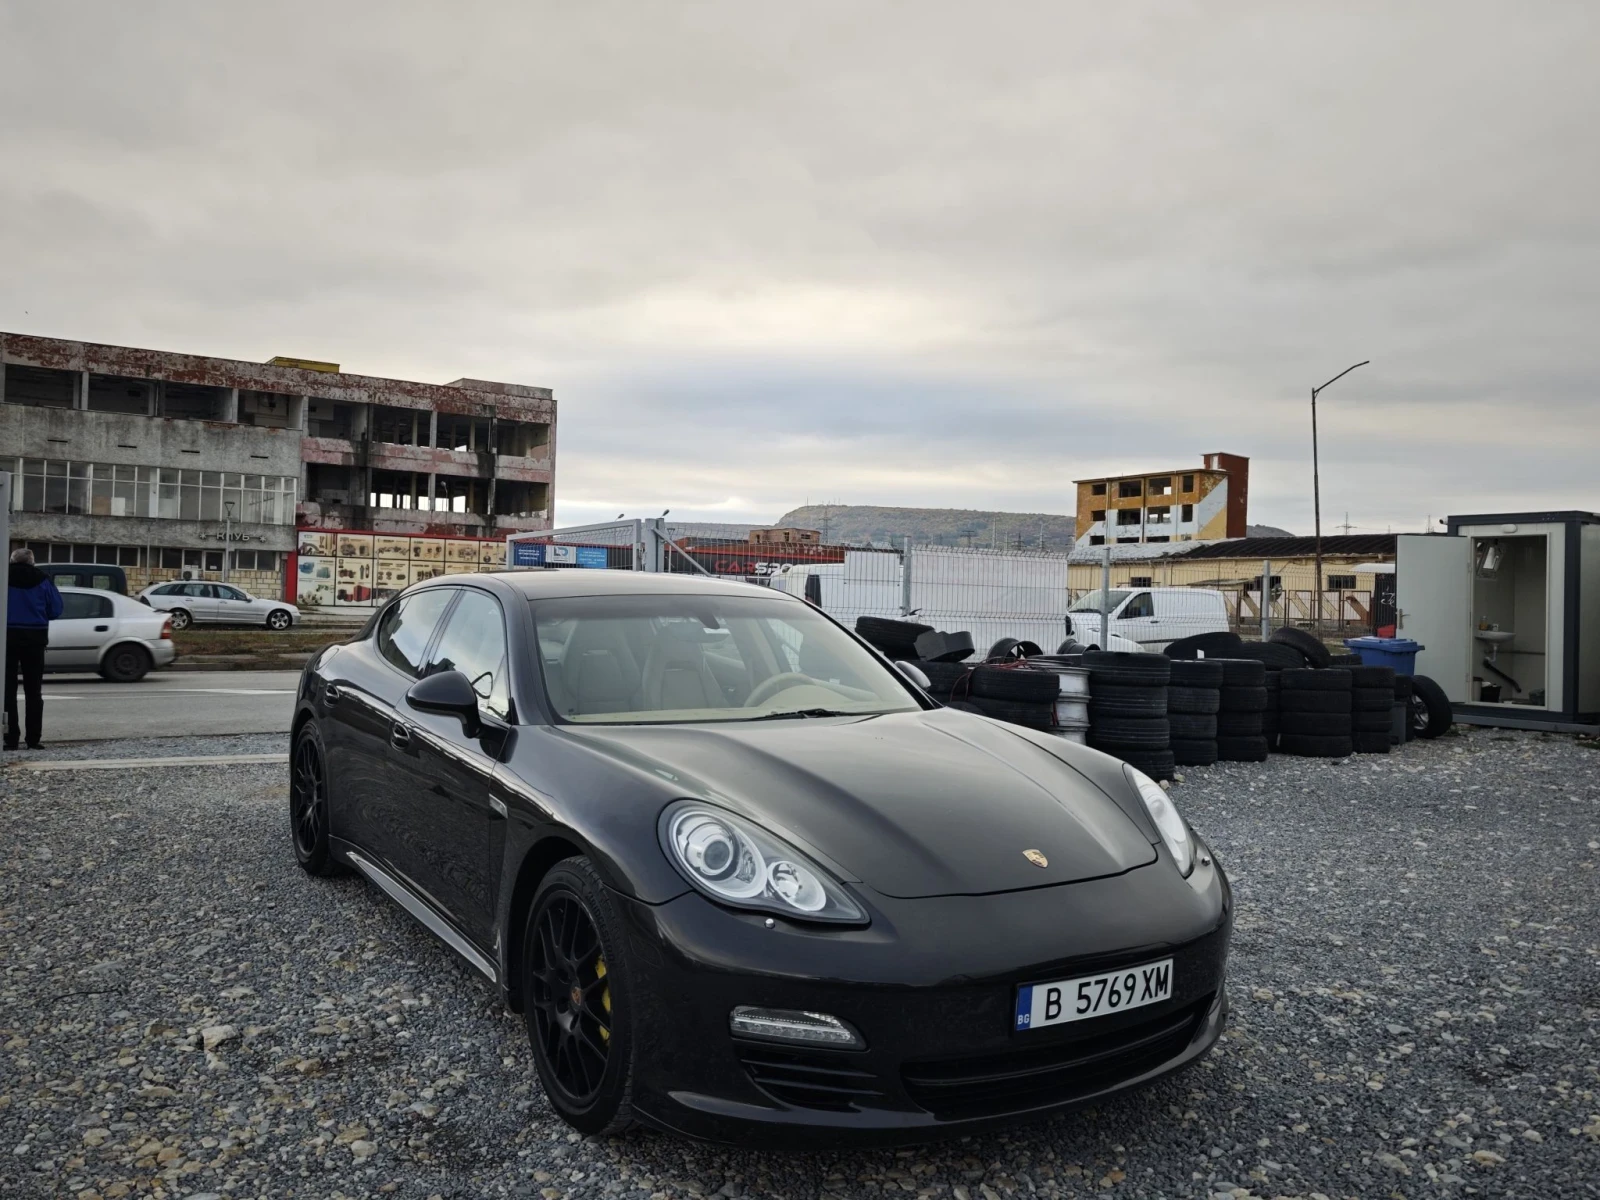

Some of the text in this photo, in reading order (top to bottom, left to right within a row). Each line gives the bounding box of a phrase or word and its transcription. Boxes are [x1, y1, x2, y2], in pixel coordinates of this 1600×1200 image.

[1045, 987, 1062, 1021] B
[1076, 973, 1137, 1015] 5769
[1017, 1013, 1030, 1025] BG
